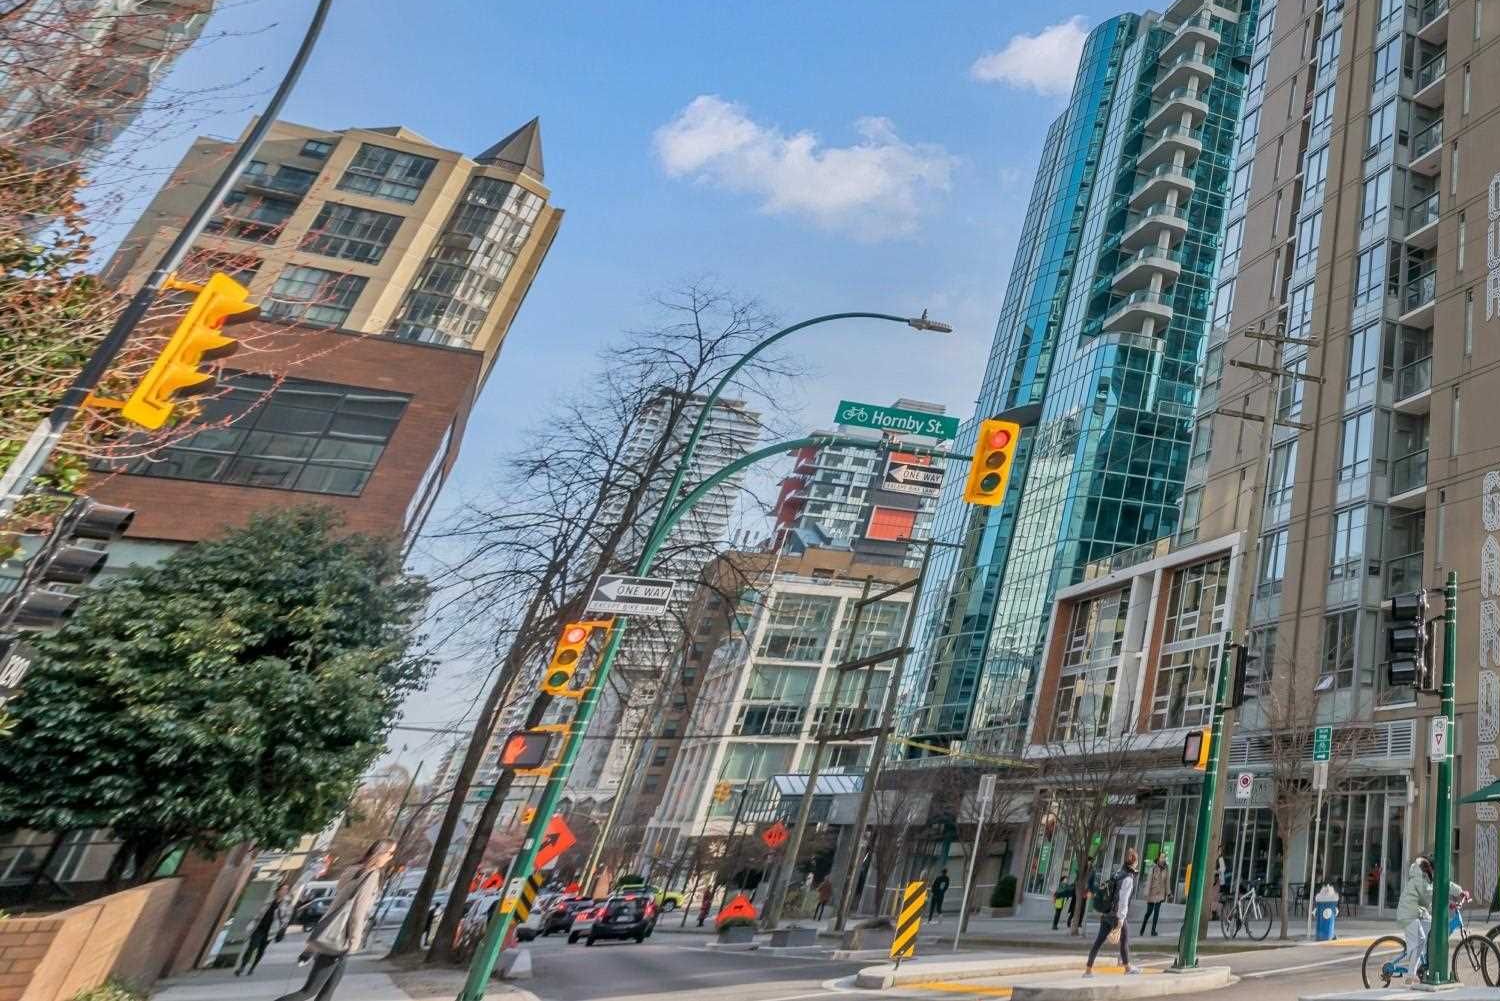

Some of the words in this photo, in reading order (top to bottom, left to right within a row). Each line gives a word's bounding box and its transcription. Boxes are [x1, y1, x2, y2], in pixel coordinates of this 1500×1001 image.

[871, 410, 925, 434] Hornby
[926, 419, 945, 434] St.
[903, 470, 920, 480] ONE
[923, 473, 940, 482] WAY
[617, 585, 640, 596] ONE
[644, 587, 667, 598] WAY
